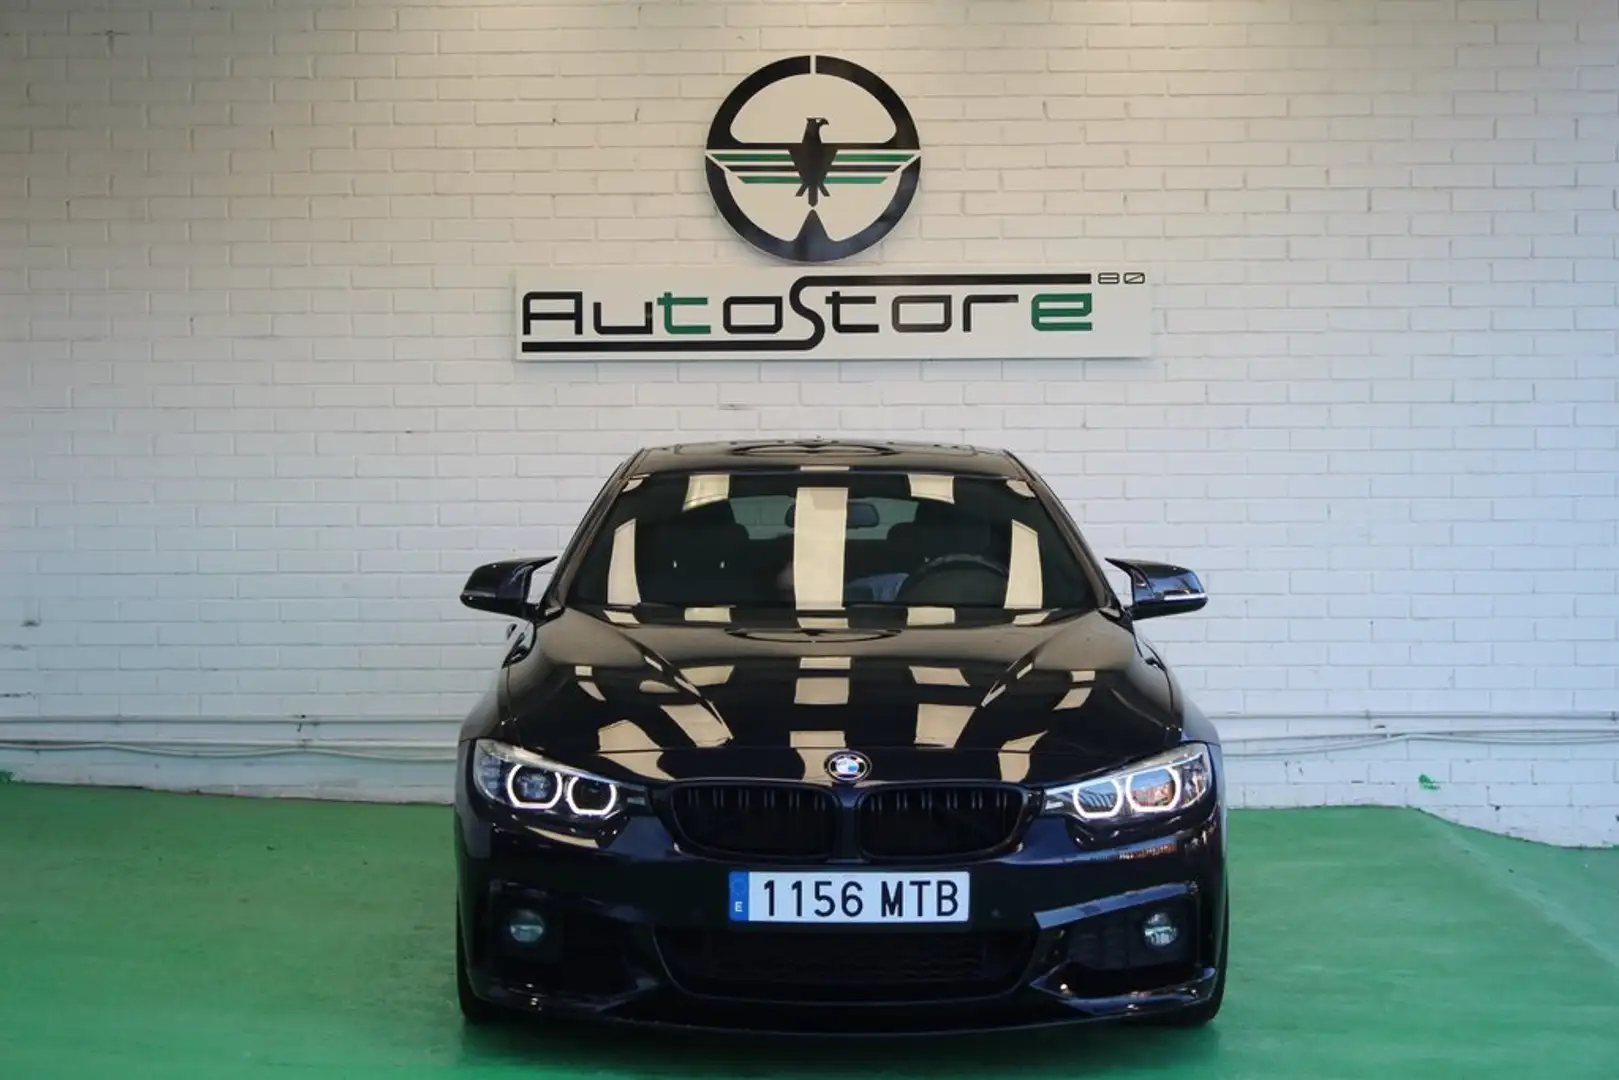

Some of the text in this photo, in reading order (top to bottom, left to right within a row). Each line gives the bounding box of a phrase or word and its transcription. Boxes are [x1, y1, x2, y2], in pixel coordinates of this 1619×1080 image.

[734, 901, 744, 912] E
[763, 879, 959, 918] 1156 MTB
